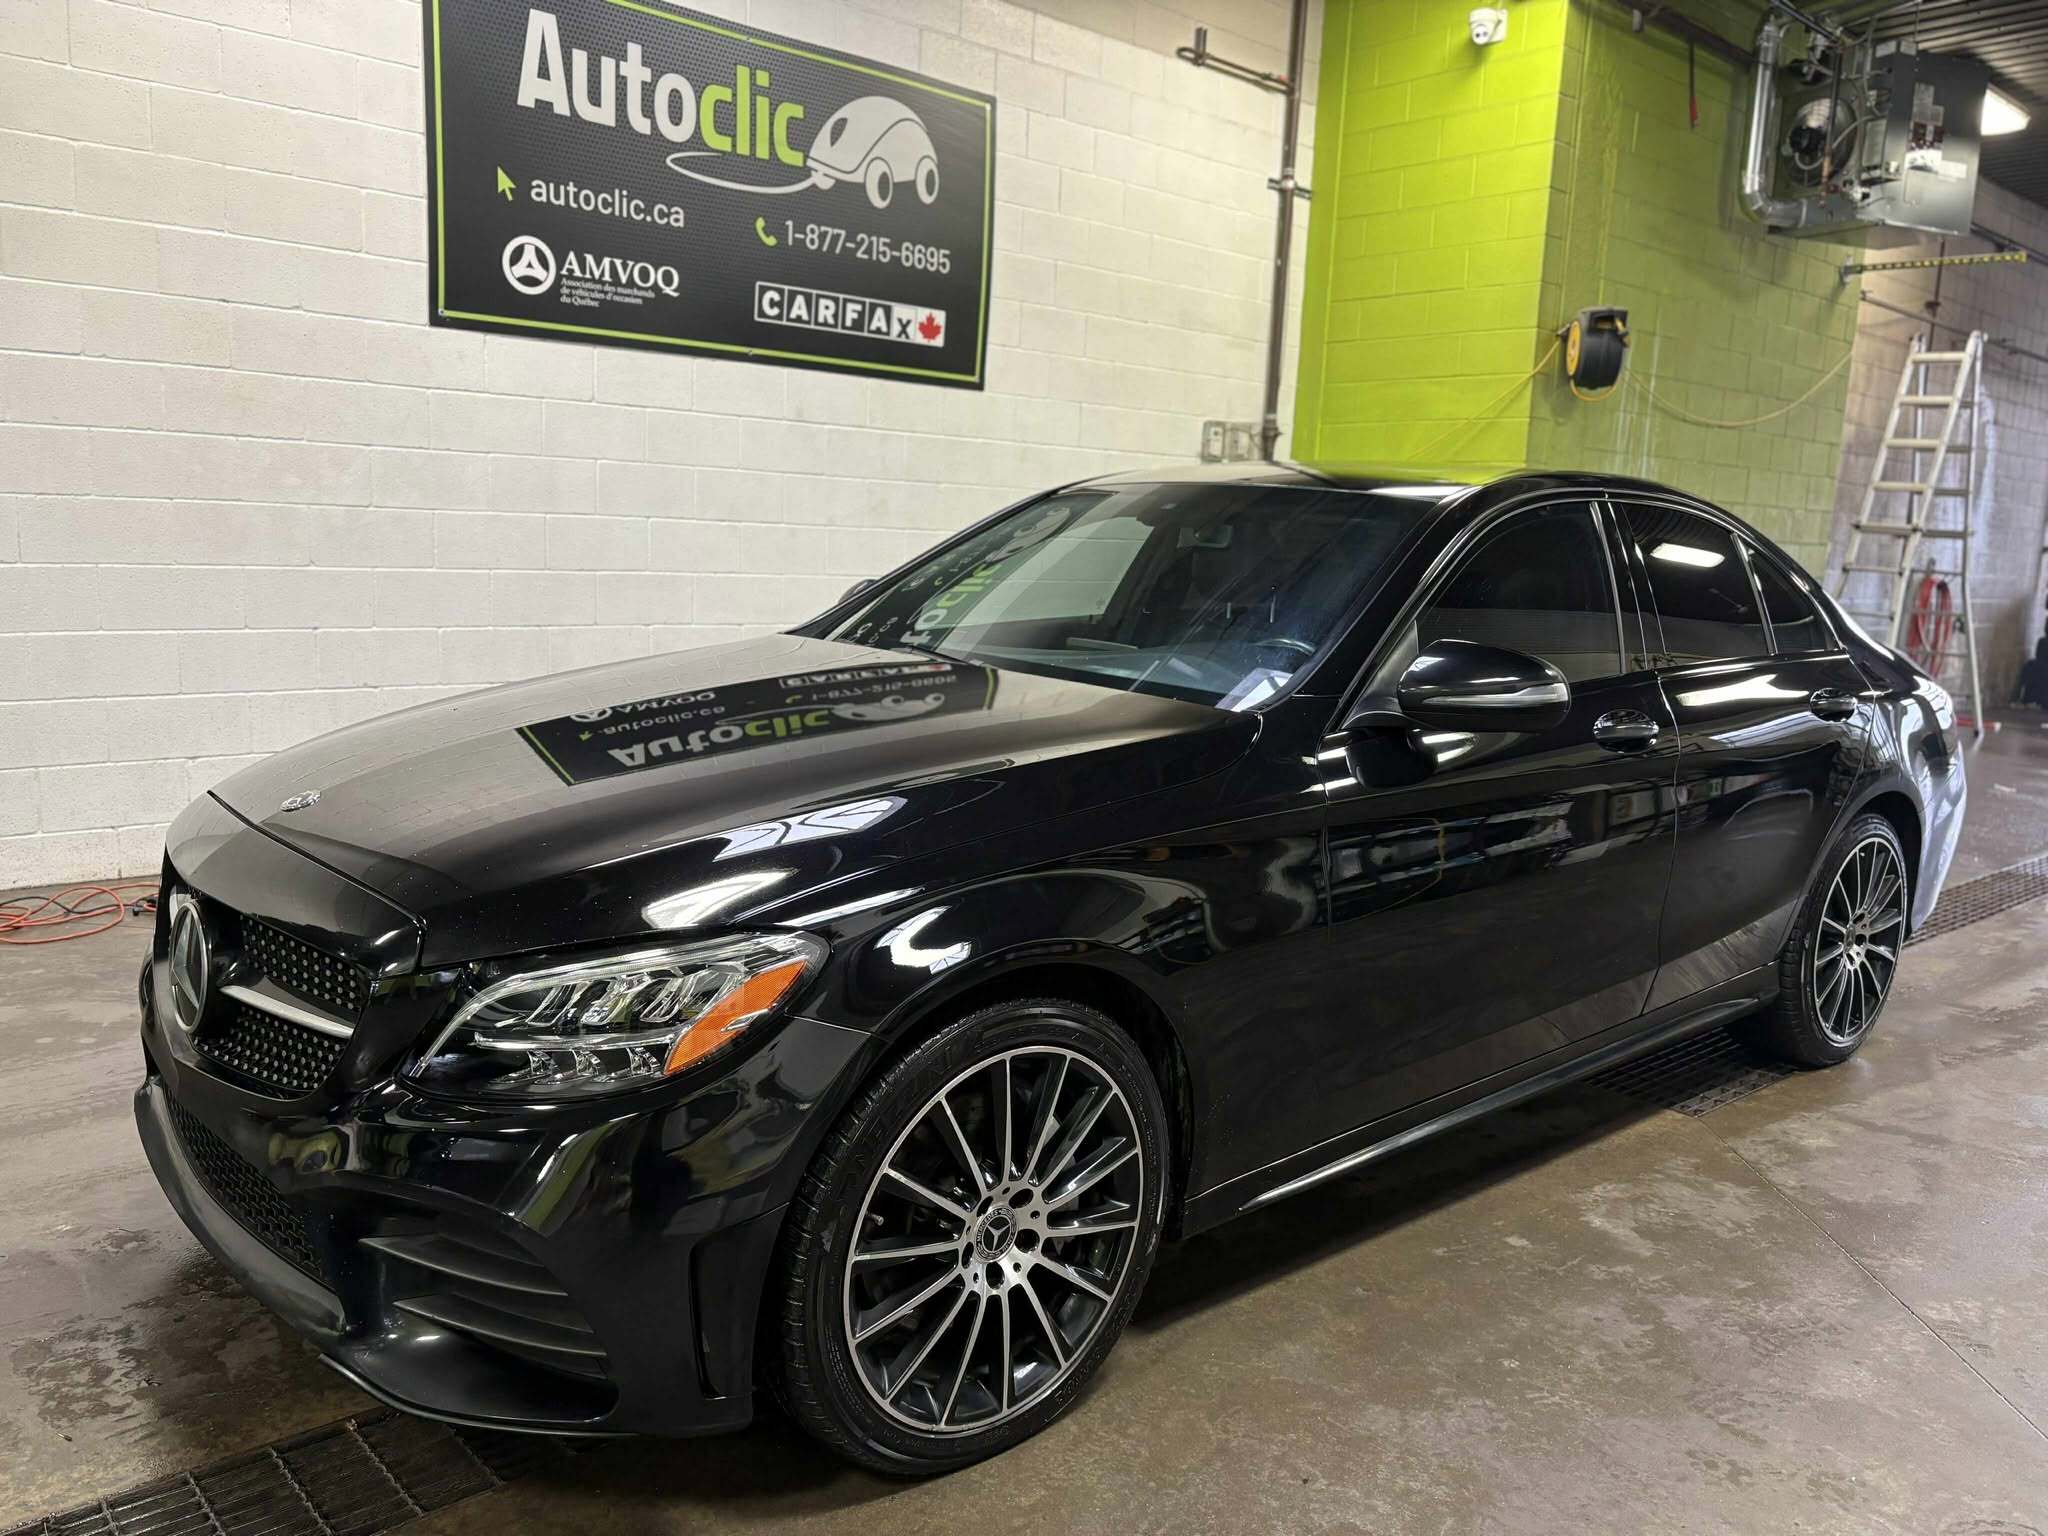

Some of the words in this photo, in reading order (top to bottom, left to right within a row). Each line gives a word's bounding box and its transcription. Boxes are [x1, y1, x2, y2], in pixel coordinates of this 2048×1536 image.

[516, 8, 804, 168] Autoclic
[530, 178, 685, 228] autoclic.ca
[784, 220, 951, 274] 1-877-215-6695
[560, 250, 680, 297] AMVOQ
[761, 290, 911, 340] CARFAX
